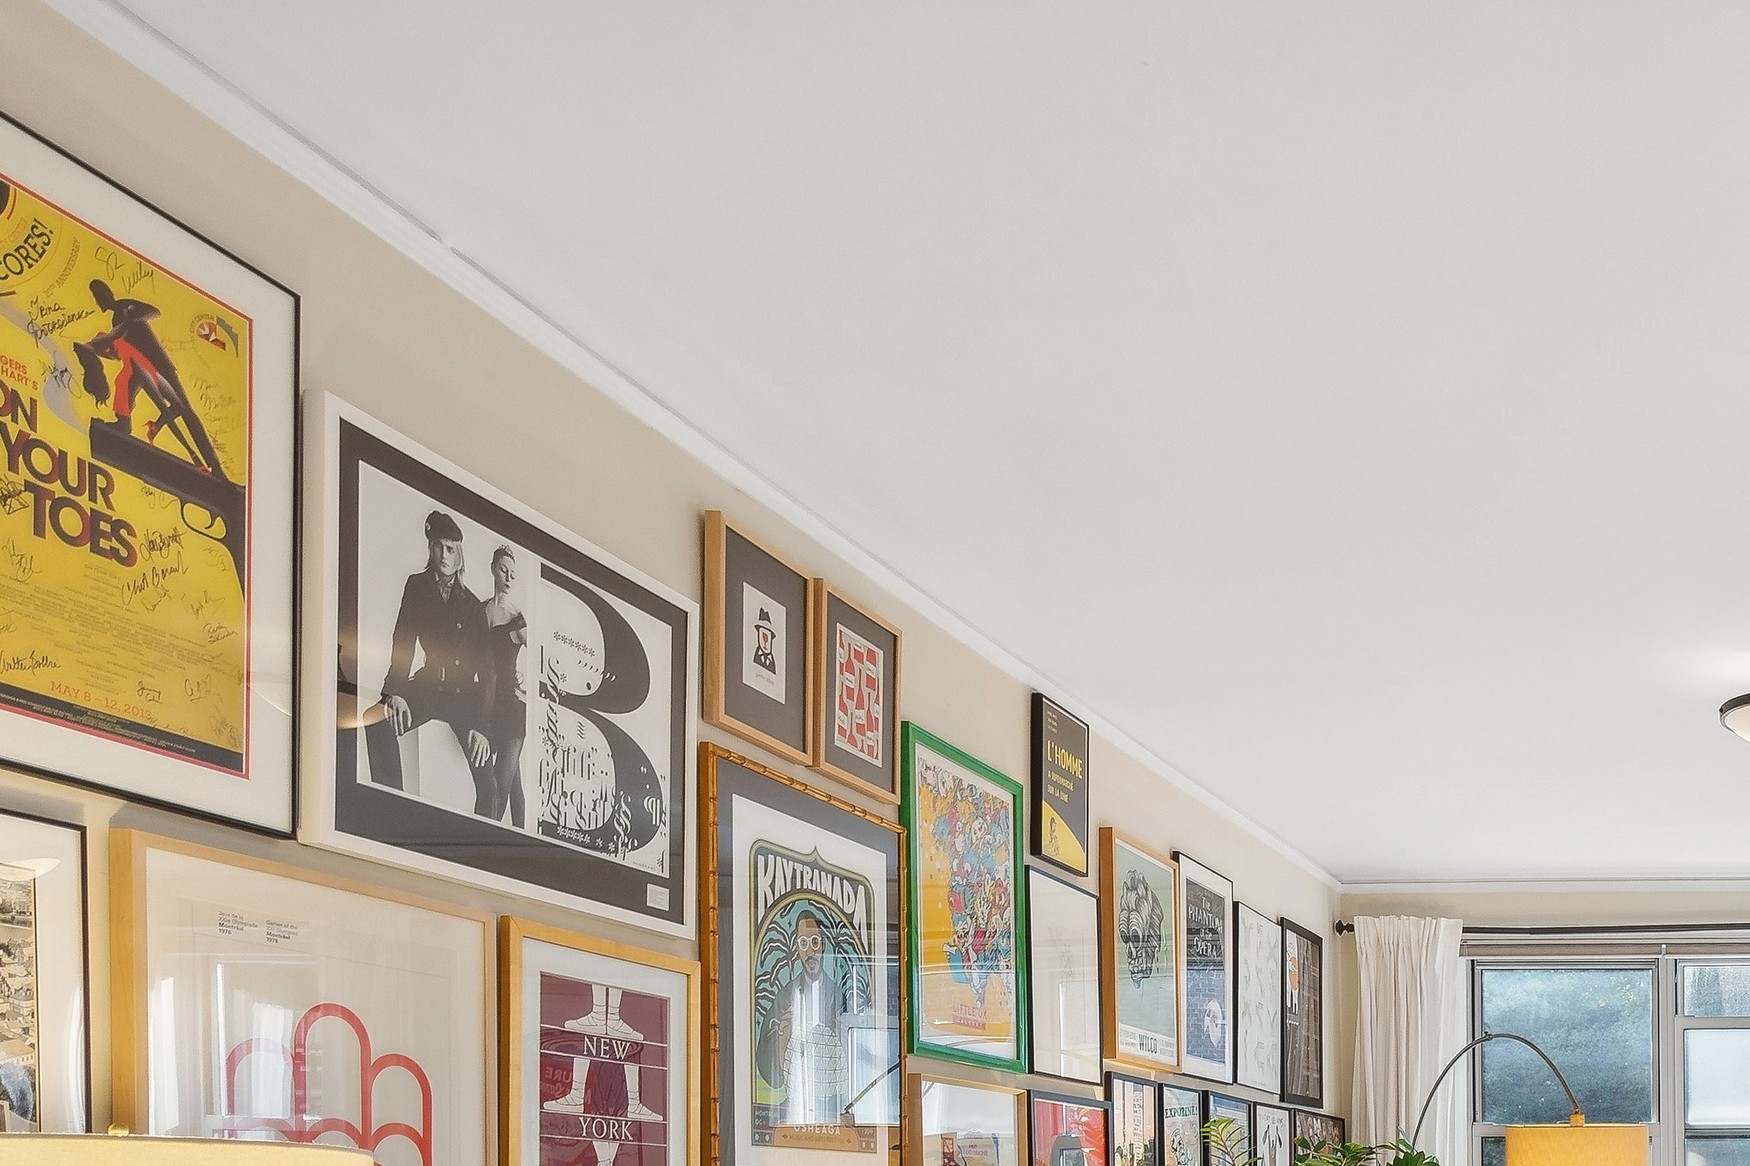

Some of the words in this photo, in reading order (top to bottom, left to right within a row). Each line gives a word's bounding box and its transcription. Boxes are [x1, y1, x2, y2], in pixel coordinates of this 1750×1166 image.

[1, 366, 38, 391] HART'S
[0, 420, 116, 513] YOUR
[24, 478, 137, 568] TOES
[50, 681, 80, 698] MAY
[83, 692, 92, 702] 8
[123, 703, 153, 721] 2013
[1047, 740, 1083, 779] L'HOMME
[757, 854, 869, 955] KAYTRANADA
[1188, 904, 1223, 934] PHANTOM
[1193, 936, 1217, 959] OPERA
[582, 1036, 630, 1061] NEW
[1138, 1033, 1157, 1054] WILCO
[1164, 1105, 1198, 1119] EXPOZINE!
[578, 1116, 634, 1142] YORK
[793, 1123, 841, 1136] OSHEAGA
